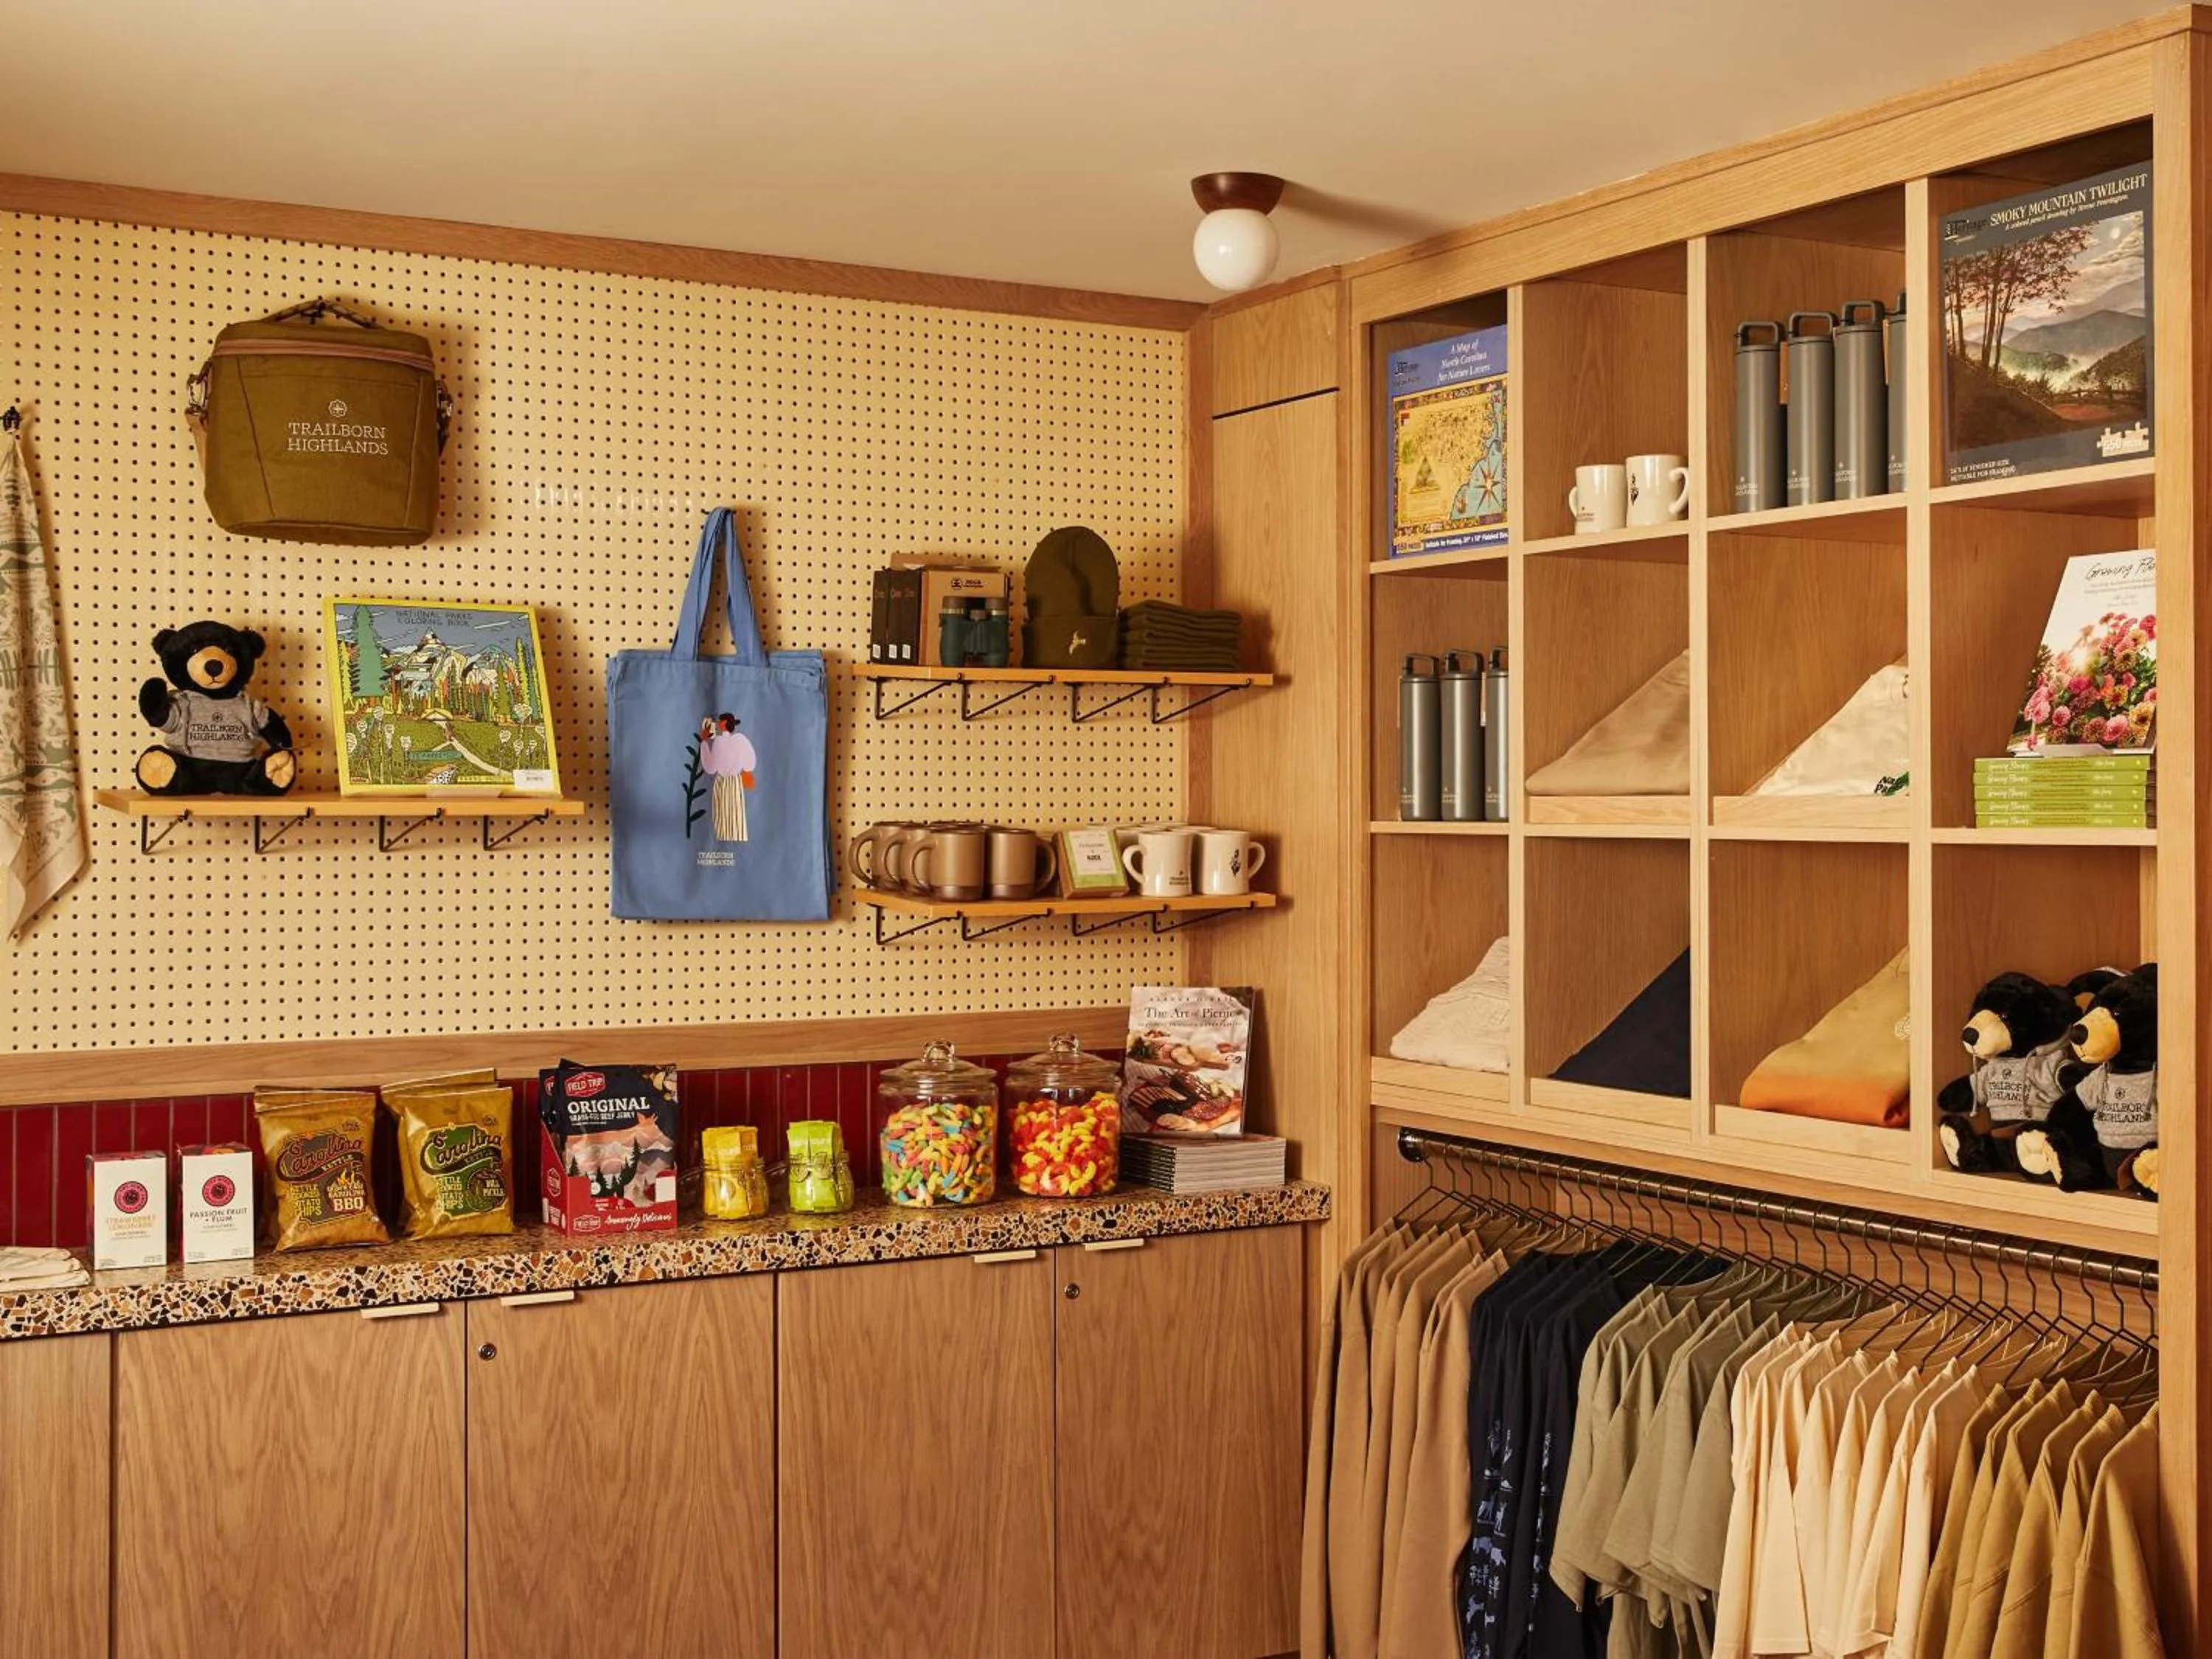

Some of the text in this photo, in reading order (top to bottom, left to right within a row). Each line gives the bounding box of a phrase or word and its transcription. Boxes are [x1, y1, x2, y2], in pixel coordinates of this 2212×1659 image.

[1990, 173, 2148, 226] SMOKY MOUNTAIN TWILIGHT
[288, 422, 386, 439] TRAILBORN
[287, 438, 389, 456] HIGHLANDS
[191, 723, 243, 733] TRAILBORN
[1144, 1006, 1167, 1018] The
[1170, 1008, 1189, 1018] Art
[1203, 1007, 1234, 1018] Picnic
[567, 1080, 586, 1093] FIELD
[587, 1077, 605, 1088] TRIP
[567, 1096, 650, 1115] ORIGINAL
[276, 1135, 363, 1182] Carolina
[419, 1127, 504, 1176] Carolina
[321, 1153, 354, 1172] KETTLE
[333, 1197, 364, 1211] BBQ
[189, 1207, 248, 1219] PASSION FRUIT
